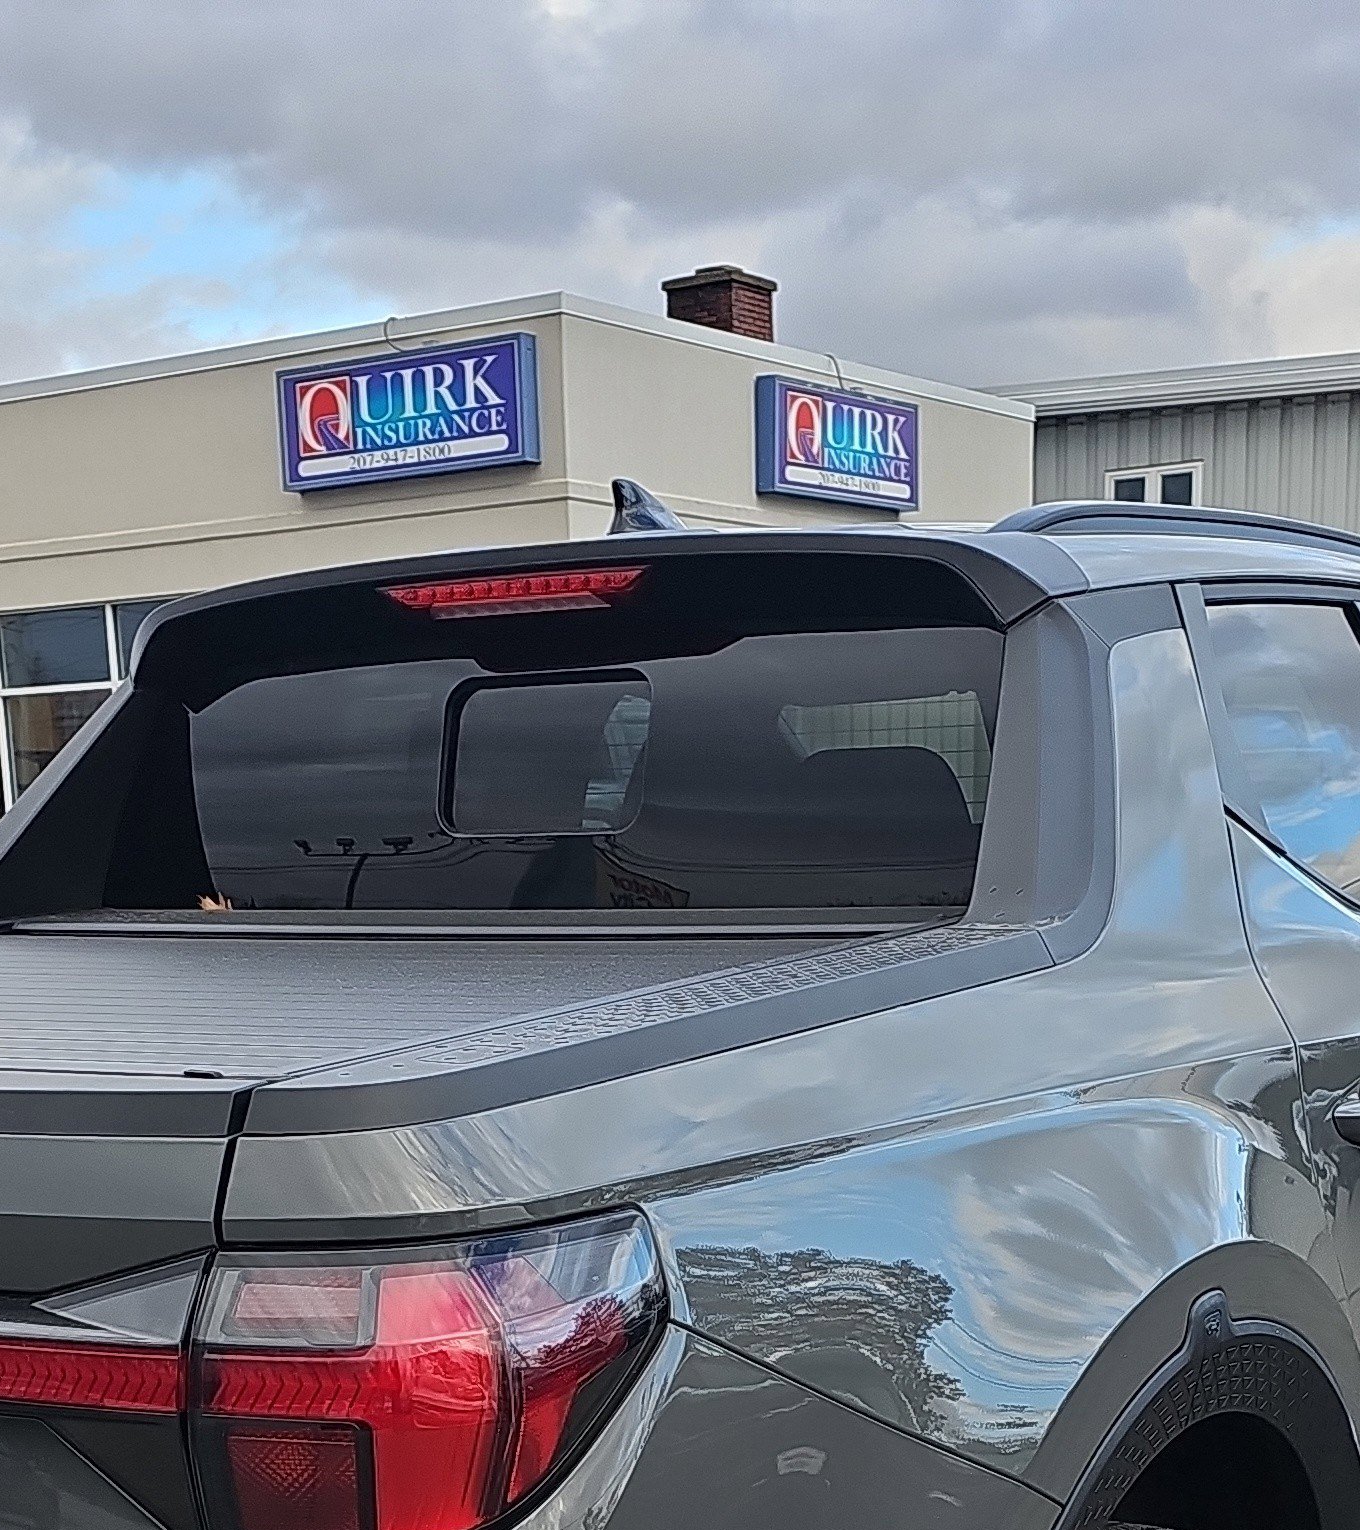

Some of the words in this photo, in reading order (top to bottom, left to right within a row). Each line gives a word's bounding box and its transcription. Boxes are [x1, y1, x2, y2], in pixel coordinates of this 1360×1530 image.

[297, 354, 507, 457] QUIRK
[354, 406, 508, 450] INSURANCE
[787, 396, 911, 463] QUIRK
[348, 443, 453, 471] 207-947-1800
[823, 447, 911, 482] INSURANCE
